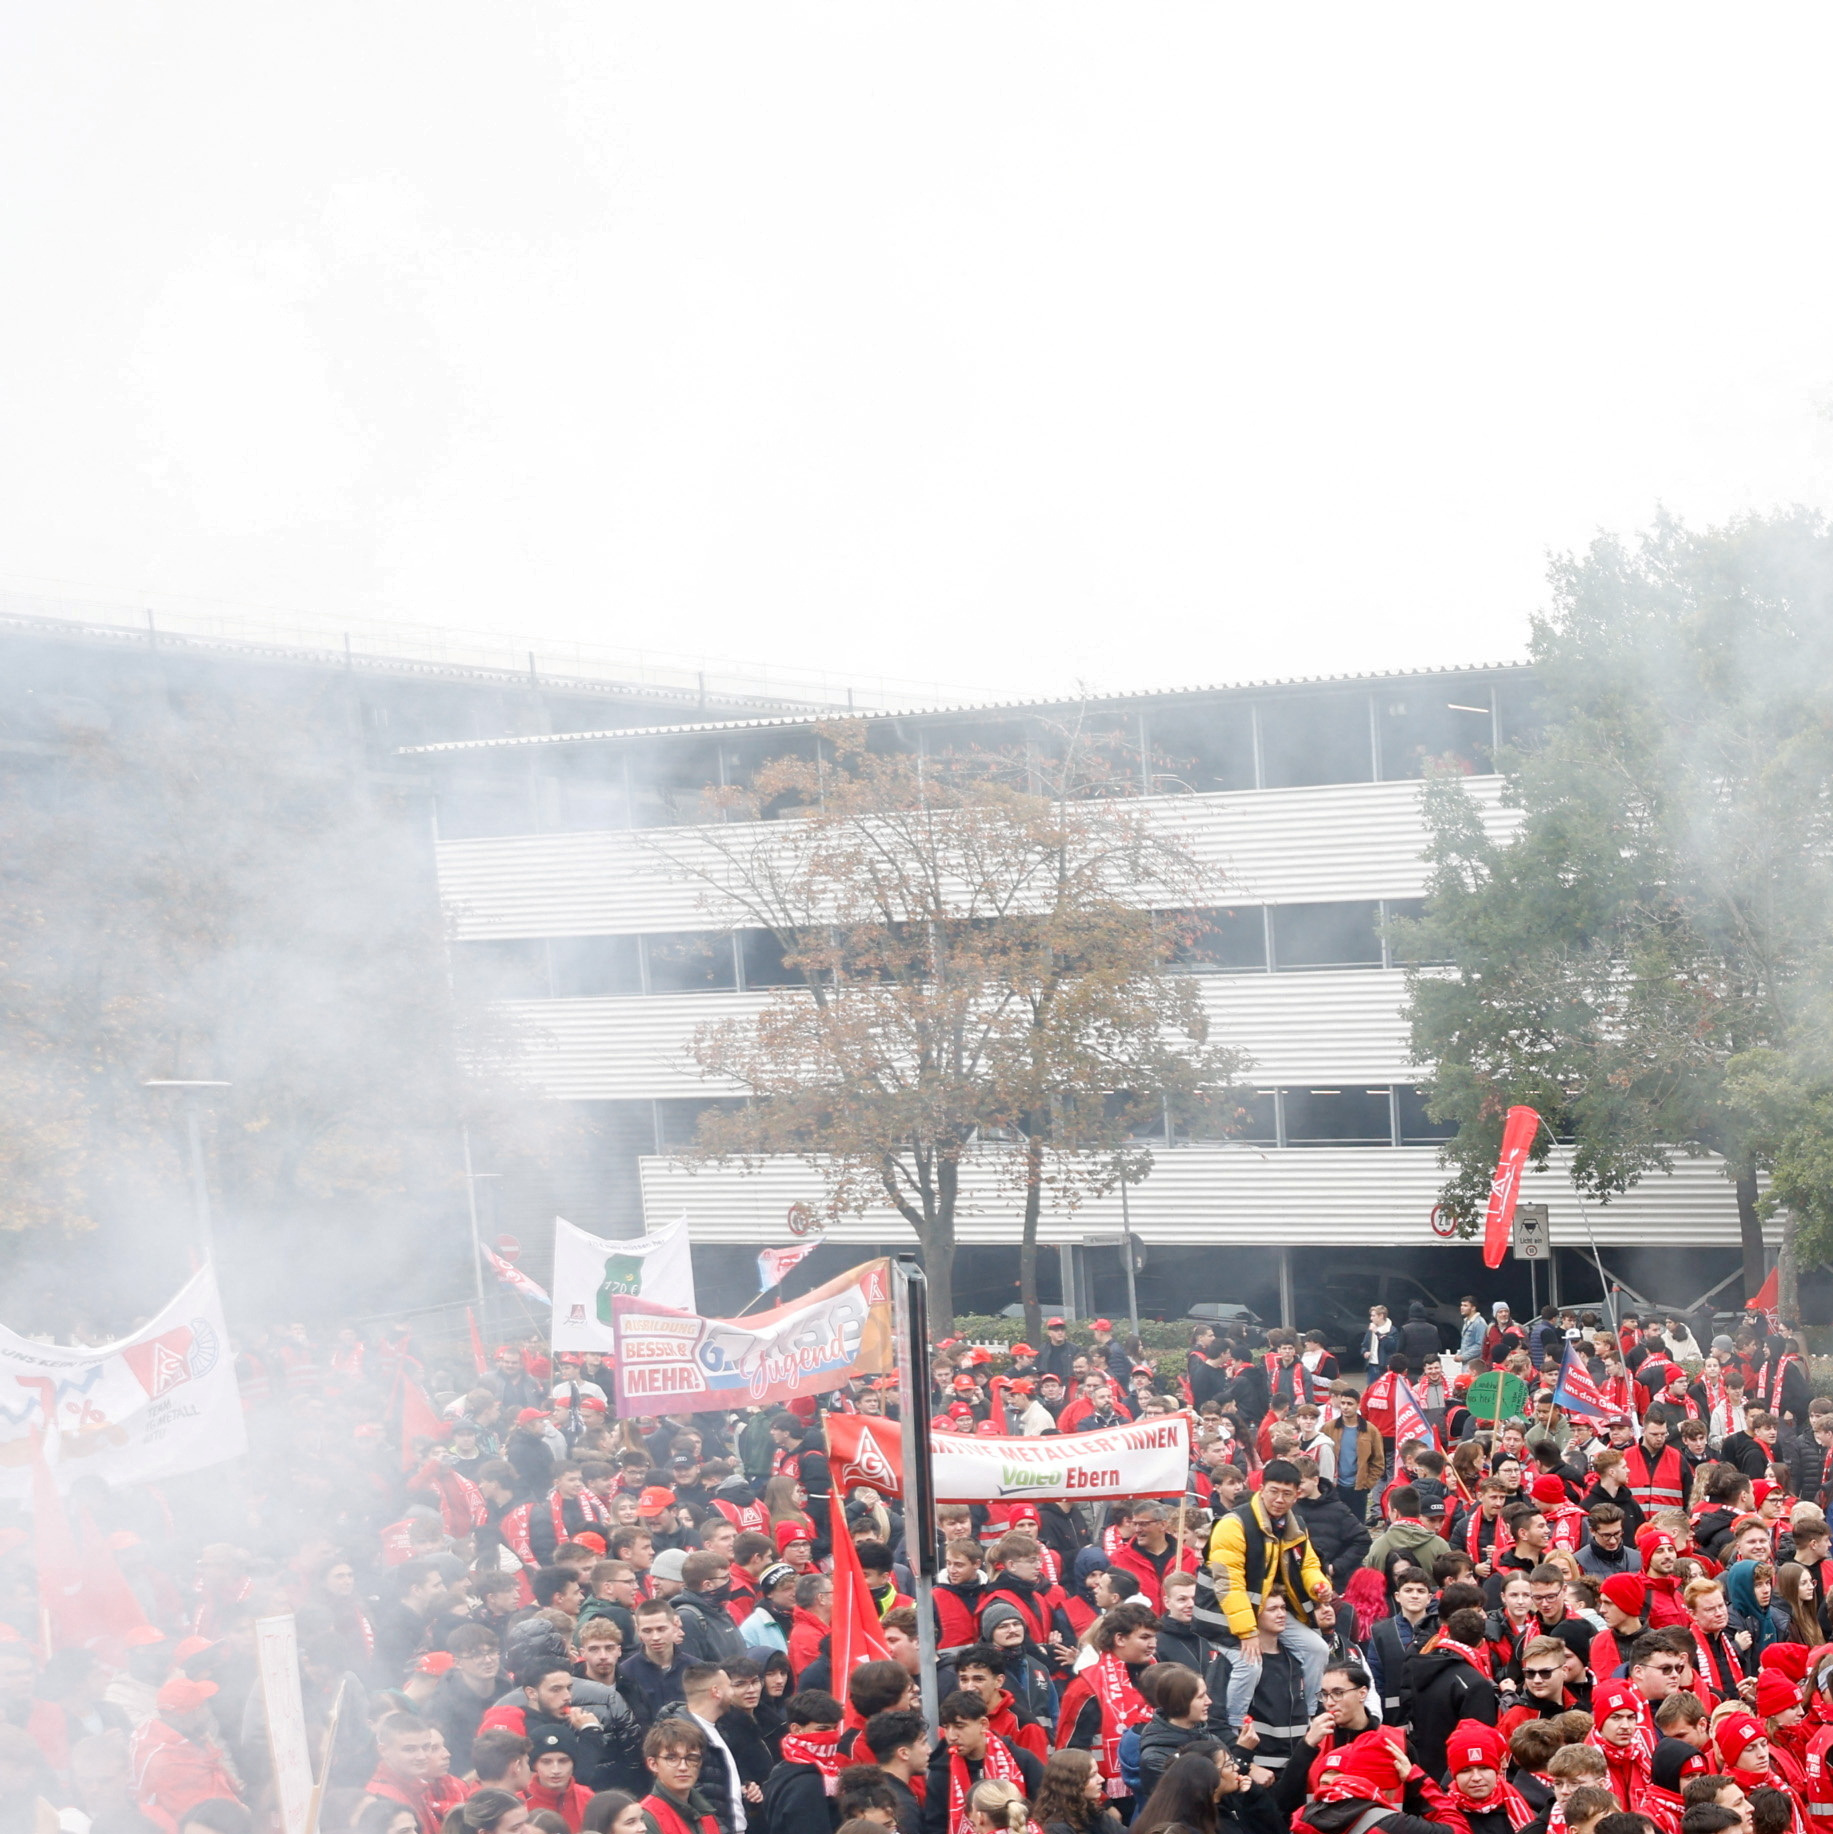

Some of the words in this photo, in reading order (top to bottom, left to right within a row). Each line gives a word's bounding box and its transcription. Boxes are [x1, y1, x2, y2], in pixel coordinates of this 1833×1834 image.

[623, 1319, 697, 1335] AUSBILDUNG
[625, 1343, 675, 1359] BESSER
[626, 1369, 702, 1397] MEHR!
[1066, 1464, 1122, 1490] Ebern
